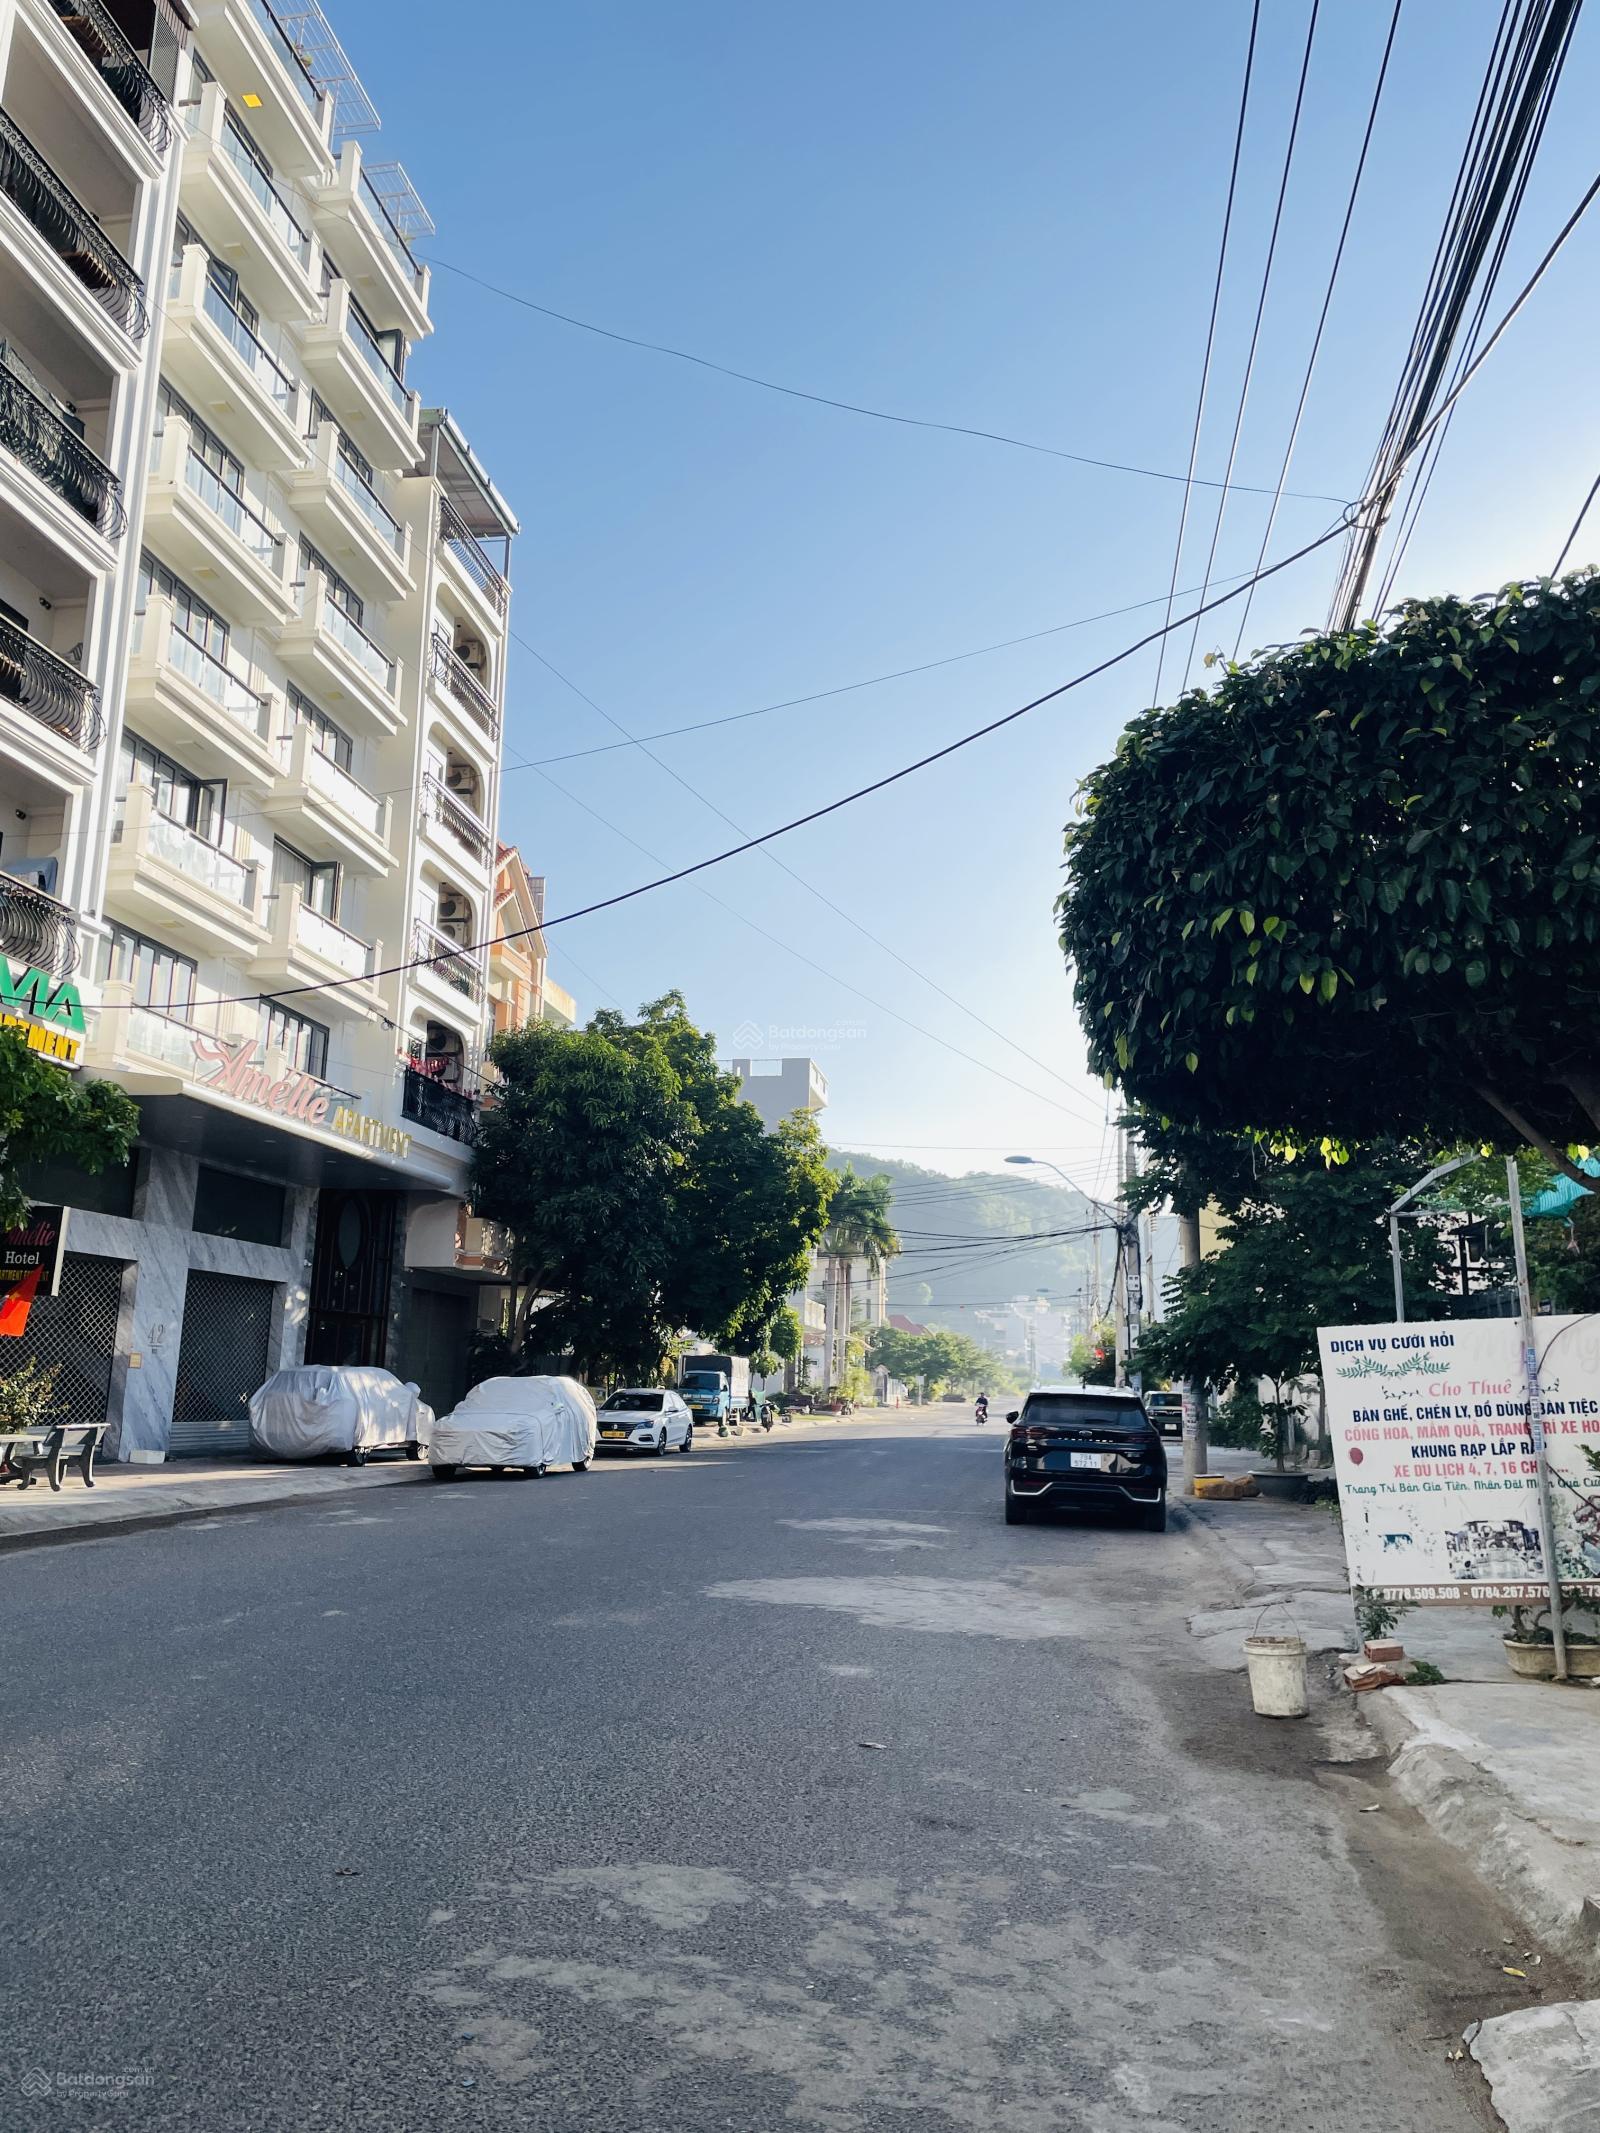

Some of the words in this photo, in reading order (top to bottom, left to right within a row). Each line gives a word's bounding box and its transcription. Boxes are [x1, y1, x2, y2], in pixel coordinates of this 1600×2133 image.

[331, 1105, 412, 1160] APARTMENT
[4, 1251, 40, 1265] Hotel
[1330, 1339, 1364, 1355] DỊCH
[1368, 1338, 1386, 1353] VỤ
[1391, 1333, 1425, 1349] CƯỚI
[1429, 1330, 1454, 1347] HỎI
[1429, 1381, 1462, 1397] Cho
[1468, 1379, 1512, 1395] Thuê
[1353, 1406, 1380, 1422] BÀN
[1383, 1403, 1413, 1421] GHẾ,
[1416, 1403, 1451, 1420] CHÉN
[1455, 1405, 1471, 1419] LY,
[1568, 1397, 1598, 1417] TIỆC
[1383, 1426, 1413, 1440] HOA,
[1542, 1419, 1557, 1435] RÍ
[1561, 1420, 1578, 1434] XE
[1411, 1444, 1457, 1458] KHUNG
[1460, 1443, 1487, 1459] RẠP
[1394, 1465, 1411, 1478] XE
[1414, 1464, 1432, 1477] DU
[1436, 1463, 1465, 1479] LỊCH
[1468, 1462, 1481, 1476] 4,
[1483, 1462, 1497, 1476] 7,
[1501, 1461, 1517, 1474] 16
[1345, 1484, 1377, 1496] Trang
[1422, 1481, 1442, 1491] Gia
[1471, 1585, 1550, 1599] 0784.267.576
